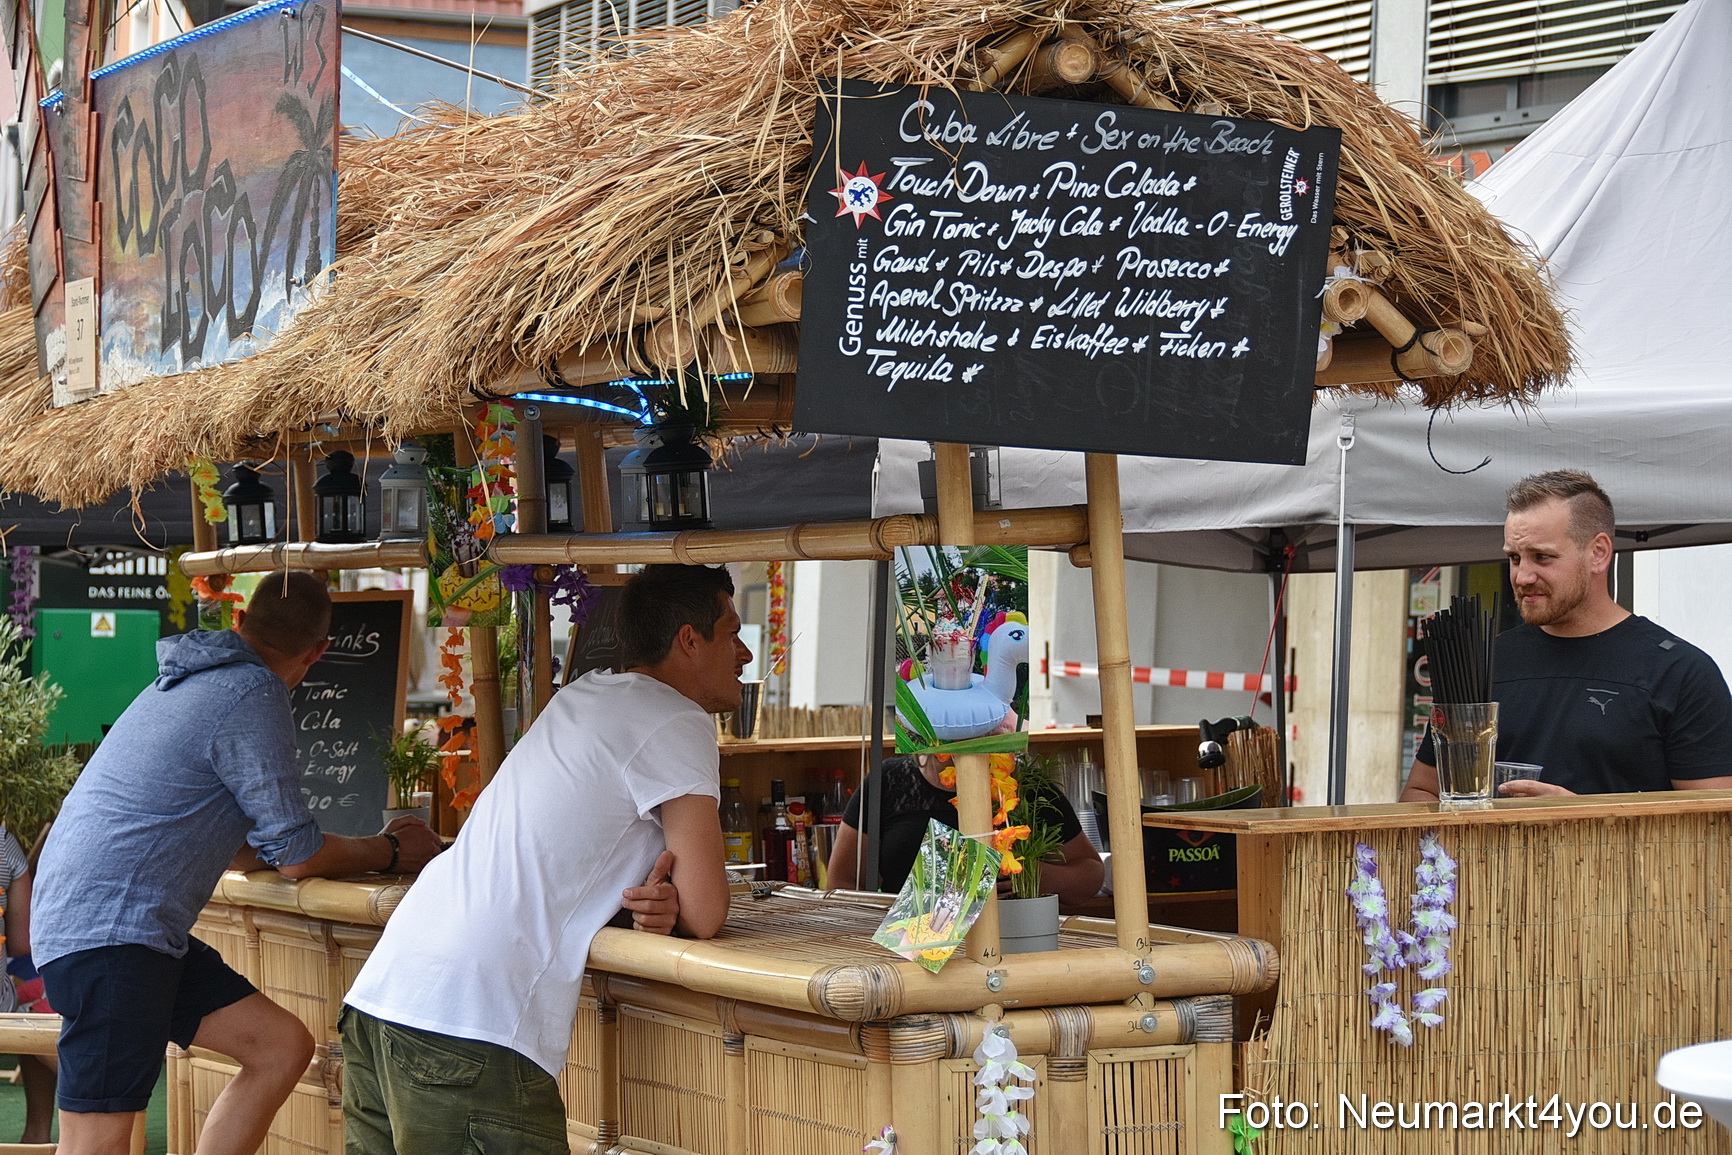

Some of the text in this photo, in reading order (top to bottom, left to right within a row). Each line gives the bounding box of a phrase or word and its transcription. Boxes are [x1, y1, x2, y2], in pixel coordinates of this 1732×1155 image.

[899, 100, 1276, 155] Cuba Libre Sex on the Beach
[885, 156, 956, 199] Touch
[957, 160, 1027, 204] Down
[1279, 148, 1300, 221] GEROLSTEINER
[1311, 185, 1320, 210] Wasser
[1316, 152, 1324, 171] Stern
[884, 203, 926, 238] Gin
[929, 209, 987, 240] Tonic
[997, 206, 1056, 250] Jacky
[1059, 205, 1104, 237] Cola
[957, 249, 1001, 277] Pils
[1016, 250, 1088, 291] Despo
[1116, 245, 1213, 281] Prosecco
[838, 238, 869, 357] Genuss mit
[869, 278, 945, 321] Aperol
[1047, 287, 1112, 320] Lillet
[875, 315, 1226, 360] Milchshake Eiskaffee Ficken
[865, 348, 956, 393] Tequila
[88, 586, 116, 599] DAS
[118, 586, 153, 600] FEINE
[301, 681, 348, 701] Tonic
[300, 708, 341, 731] Cola
[303, 760, 357, 784] Energy
